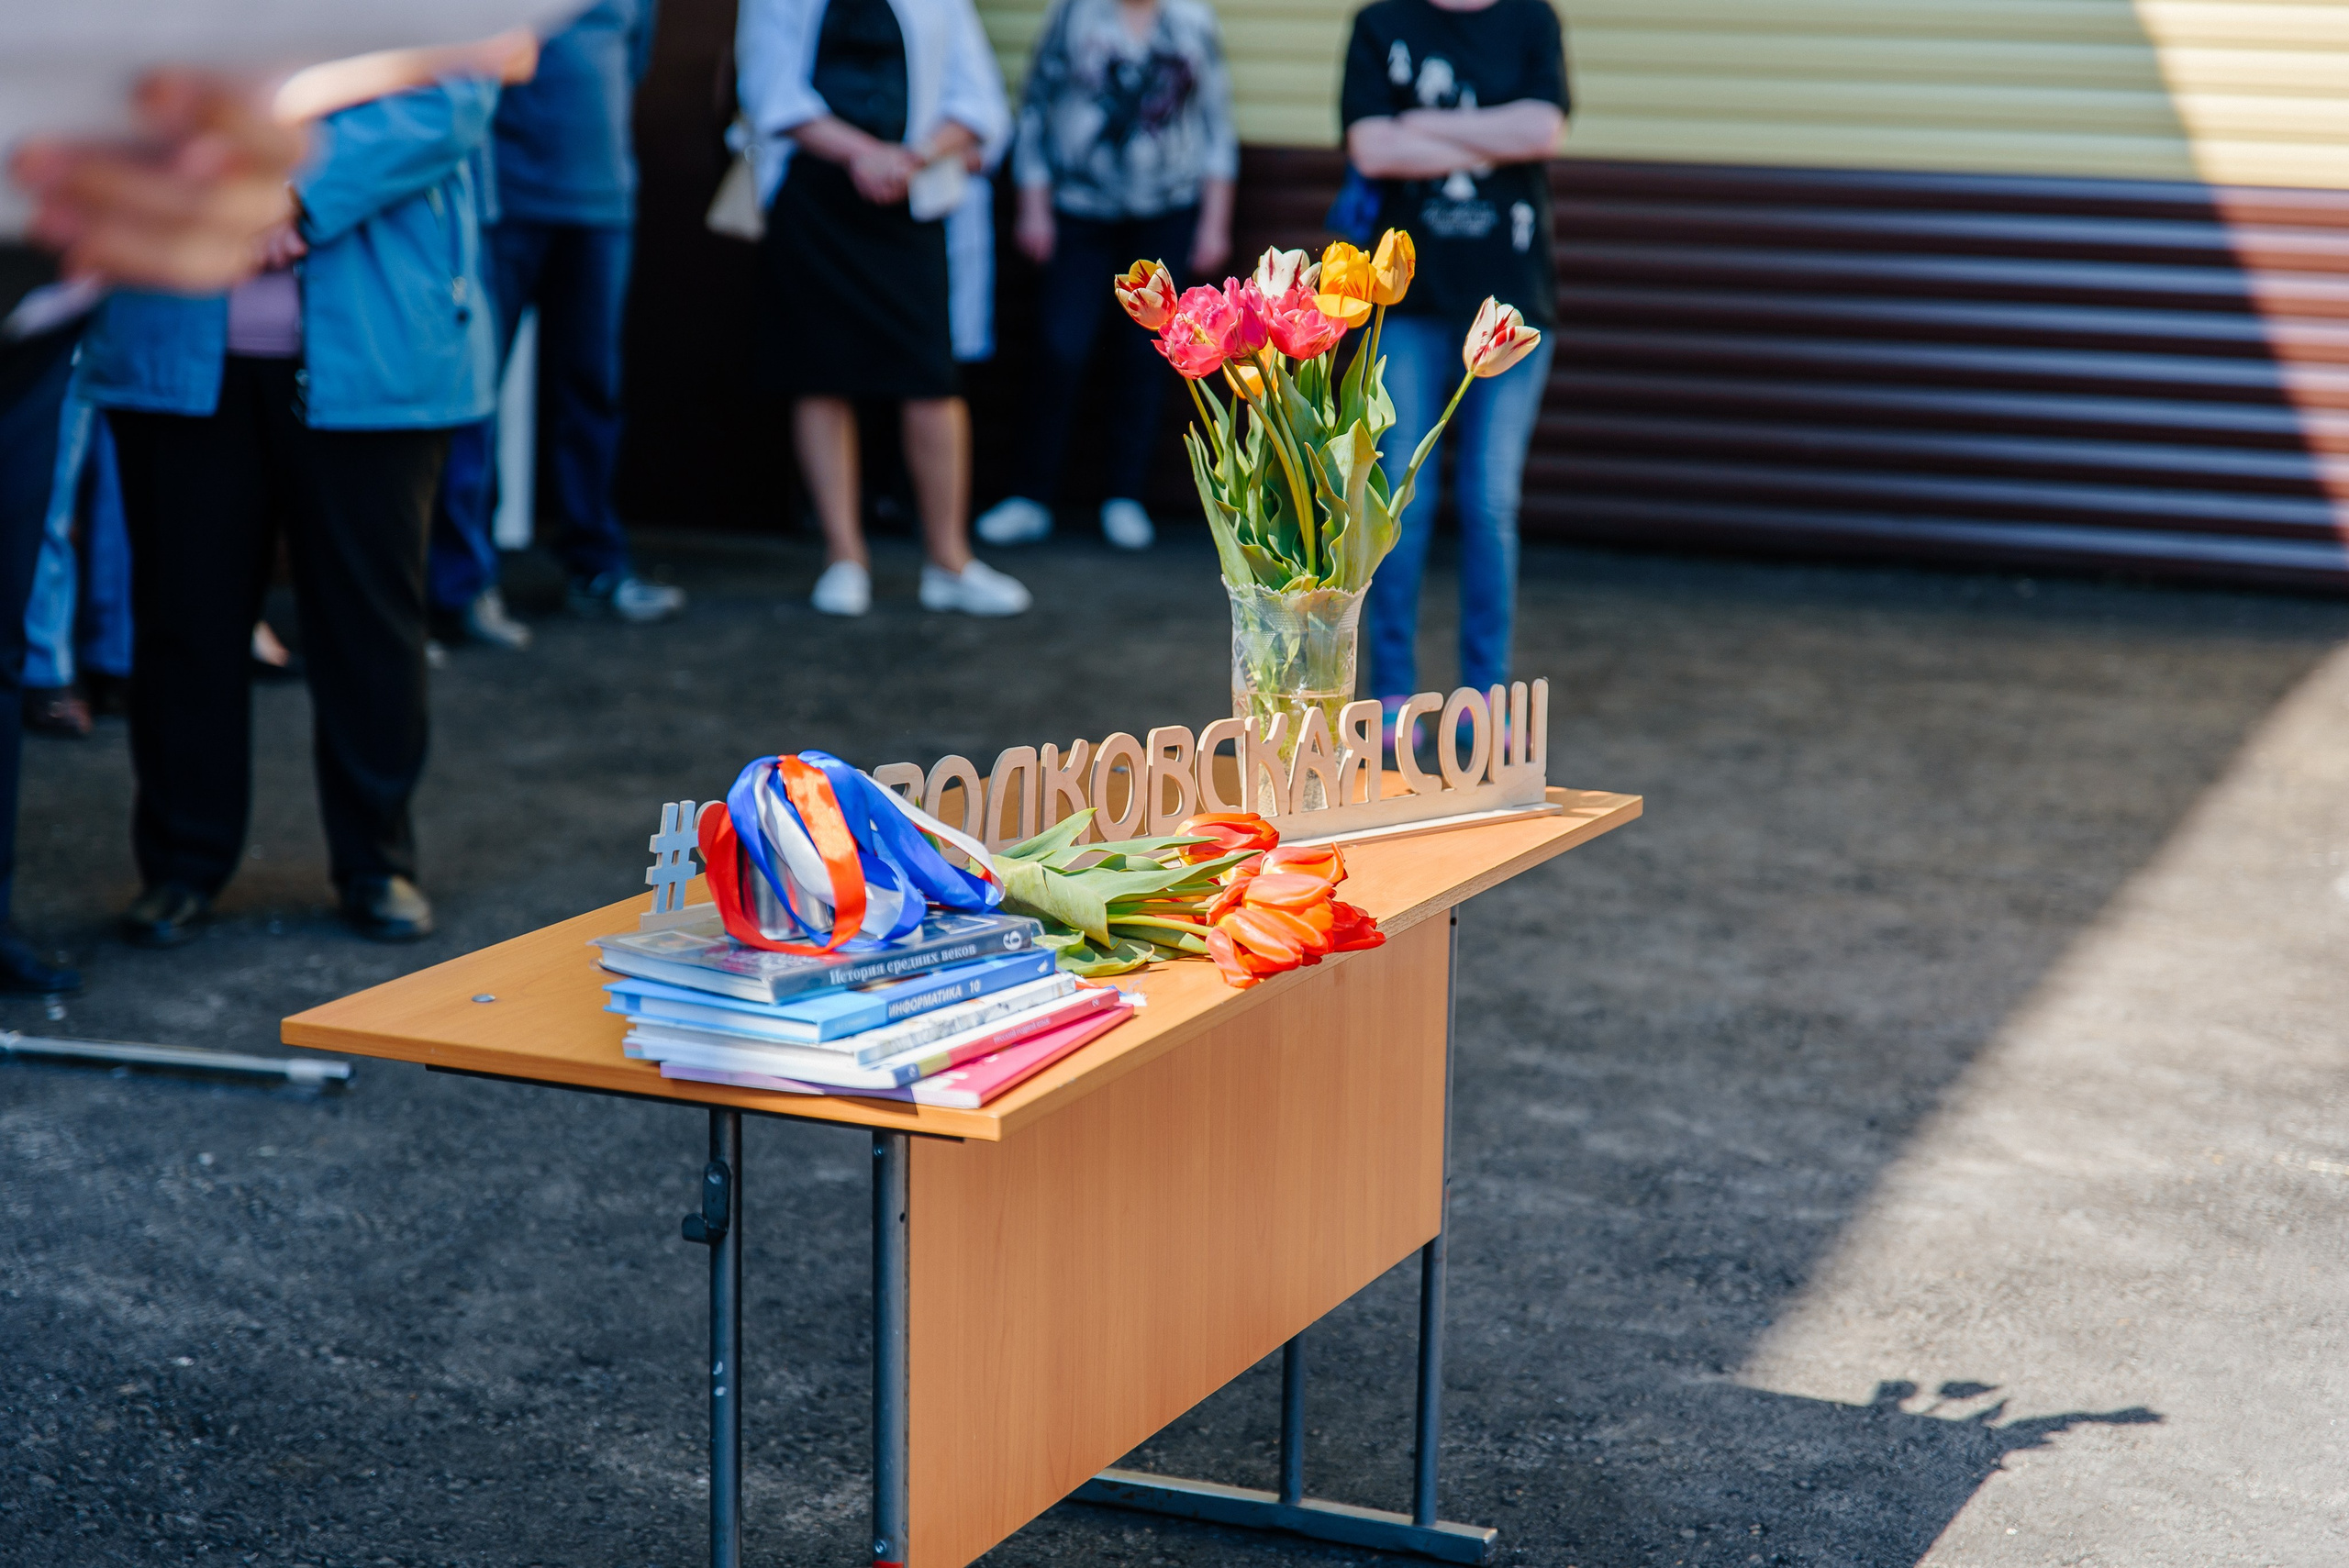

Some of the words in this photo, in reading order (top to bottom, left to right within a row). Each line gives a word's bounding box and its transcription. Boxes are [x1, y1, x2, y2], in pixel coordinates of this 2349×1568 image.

[1396, 678, 1549, 795] СОШ
[829, 960, 885, 985] История
[886, 951, 939, 975] средних
[941, 943, 976, 961] веков
[887, 984, 963, 1018] ИНФОРМАТИКА
[969, 979, 981, 995] 10
